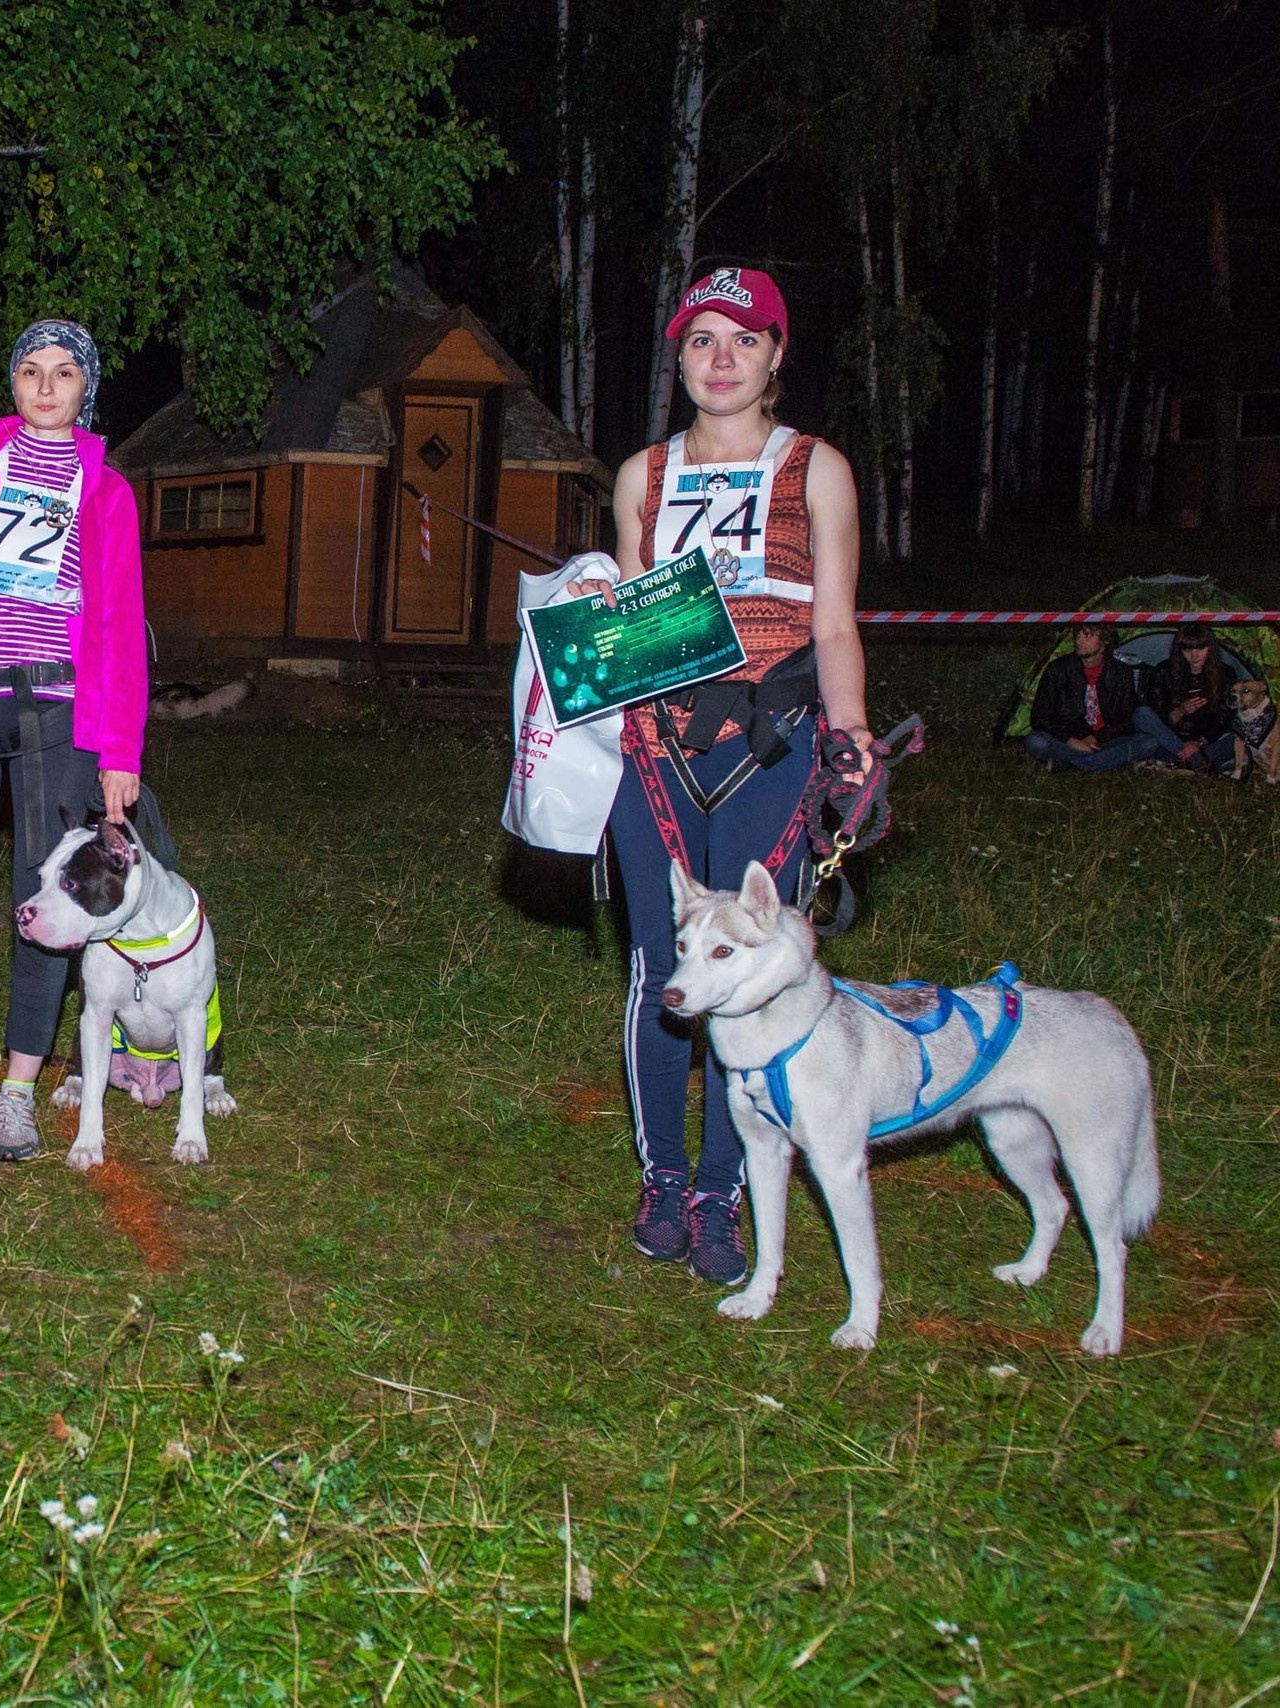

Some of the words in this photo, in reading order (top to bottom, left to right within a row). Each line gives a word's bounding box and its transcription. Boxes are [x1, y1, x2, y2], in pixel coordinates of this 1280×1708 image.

[687, 279, 750, 305] Huskies
[676, 472, 712, 493] HEY
[728, 471, 764, 489] HEY
[667, 495, 762, 554] 74
[591, 585, 636, 611] ДРАЛЕНД
[620, 604, 637, 615] 2-3
[639, 581, 682, 608] СЕНТЯБРЯ
